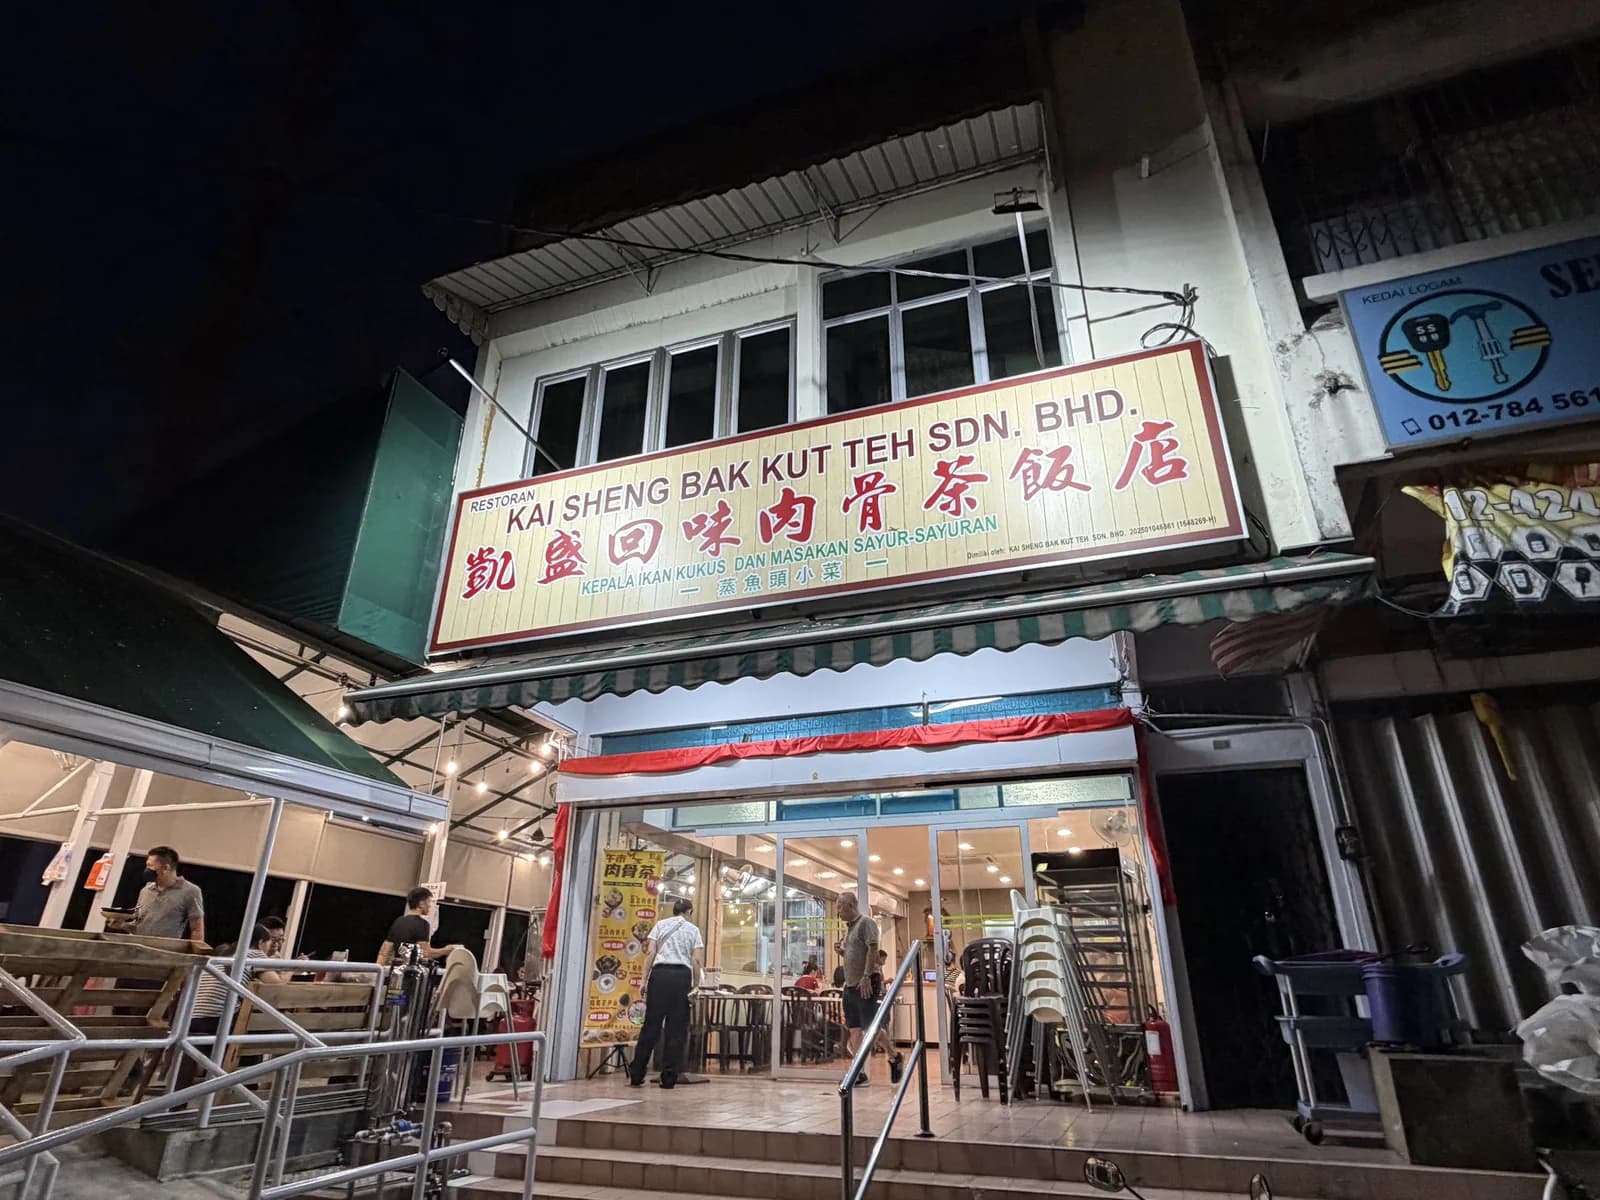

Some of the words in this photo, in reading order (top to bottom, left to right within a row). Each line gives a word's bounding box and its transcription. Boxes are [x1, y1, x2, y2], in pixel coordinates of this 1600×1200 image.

[1361, 287, 1405, 305] KEDAI
[1409, 277, 1462, 296] LOGAM
[1428, 397, 1544, 430] 012-784
[506, 500, 554, 534] KAI
[562, 477, 669, 522] SHENG
[680, 460, 751, 499] BAK
[761, 444, 832, 485] KUT
[842, 429, 914, 468] TEH
[928, 411, 1021, 452] SDN.
[1035, 388, 1137, 433] BHD.
[462, 421, 1190, 599] 凱盛回味肉骨茶飯店
[470, 489, 536, 513] RESTORAN
[581, 574, 634, 595] KEPALA
[638, 568, 672, 586] IKAN
[676, 559, 726, 580] KUKUS
[734, 554, 766, 571] DAN
[770, 540, 849, 566] MASAKAN
[854, 515, 998, 553] SAYUR-SAYURAN
[1021, 541, 1044, 551] SHENG
[1045, 539, 1060, 547] BAK
[1060, 537, 1074, 545] KUT
[1076, 535, 1089, 543] TEH
[1092, 532, 1108, 541] SDN.
[1110, 530, 1126, 538] BHD.
[719, 561, 842, 596] 蒸魚頭小菜
[604, 863, 656, 878] 肉骨茶
